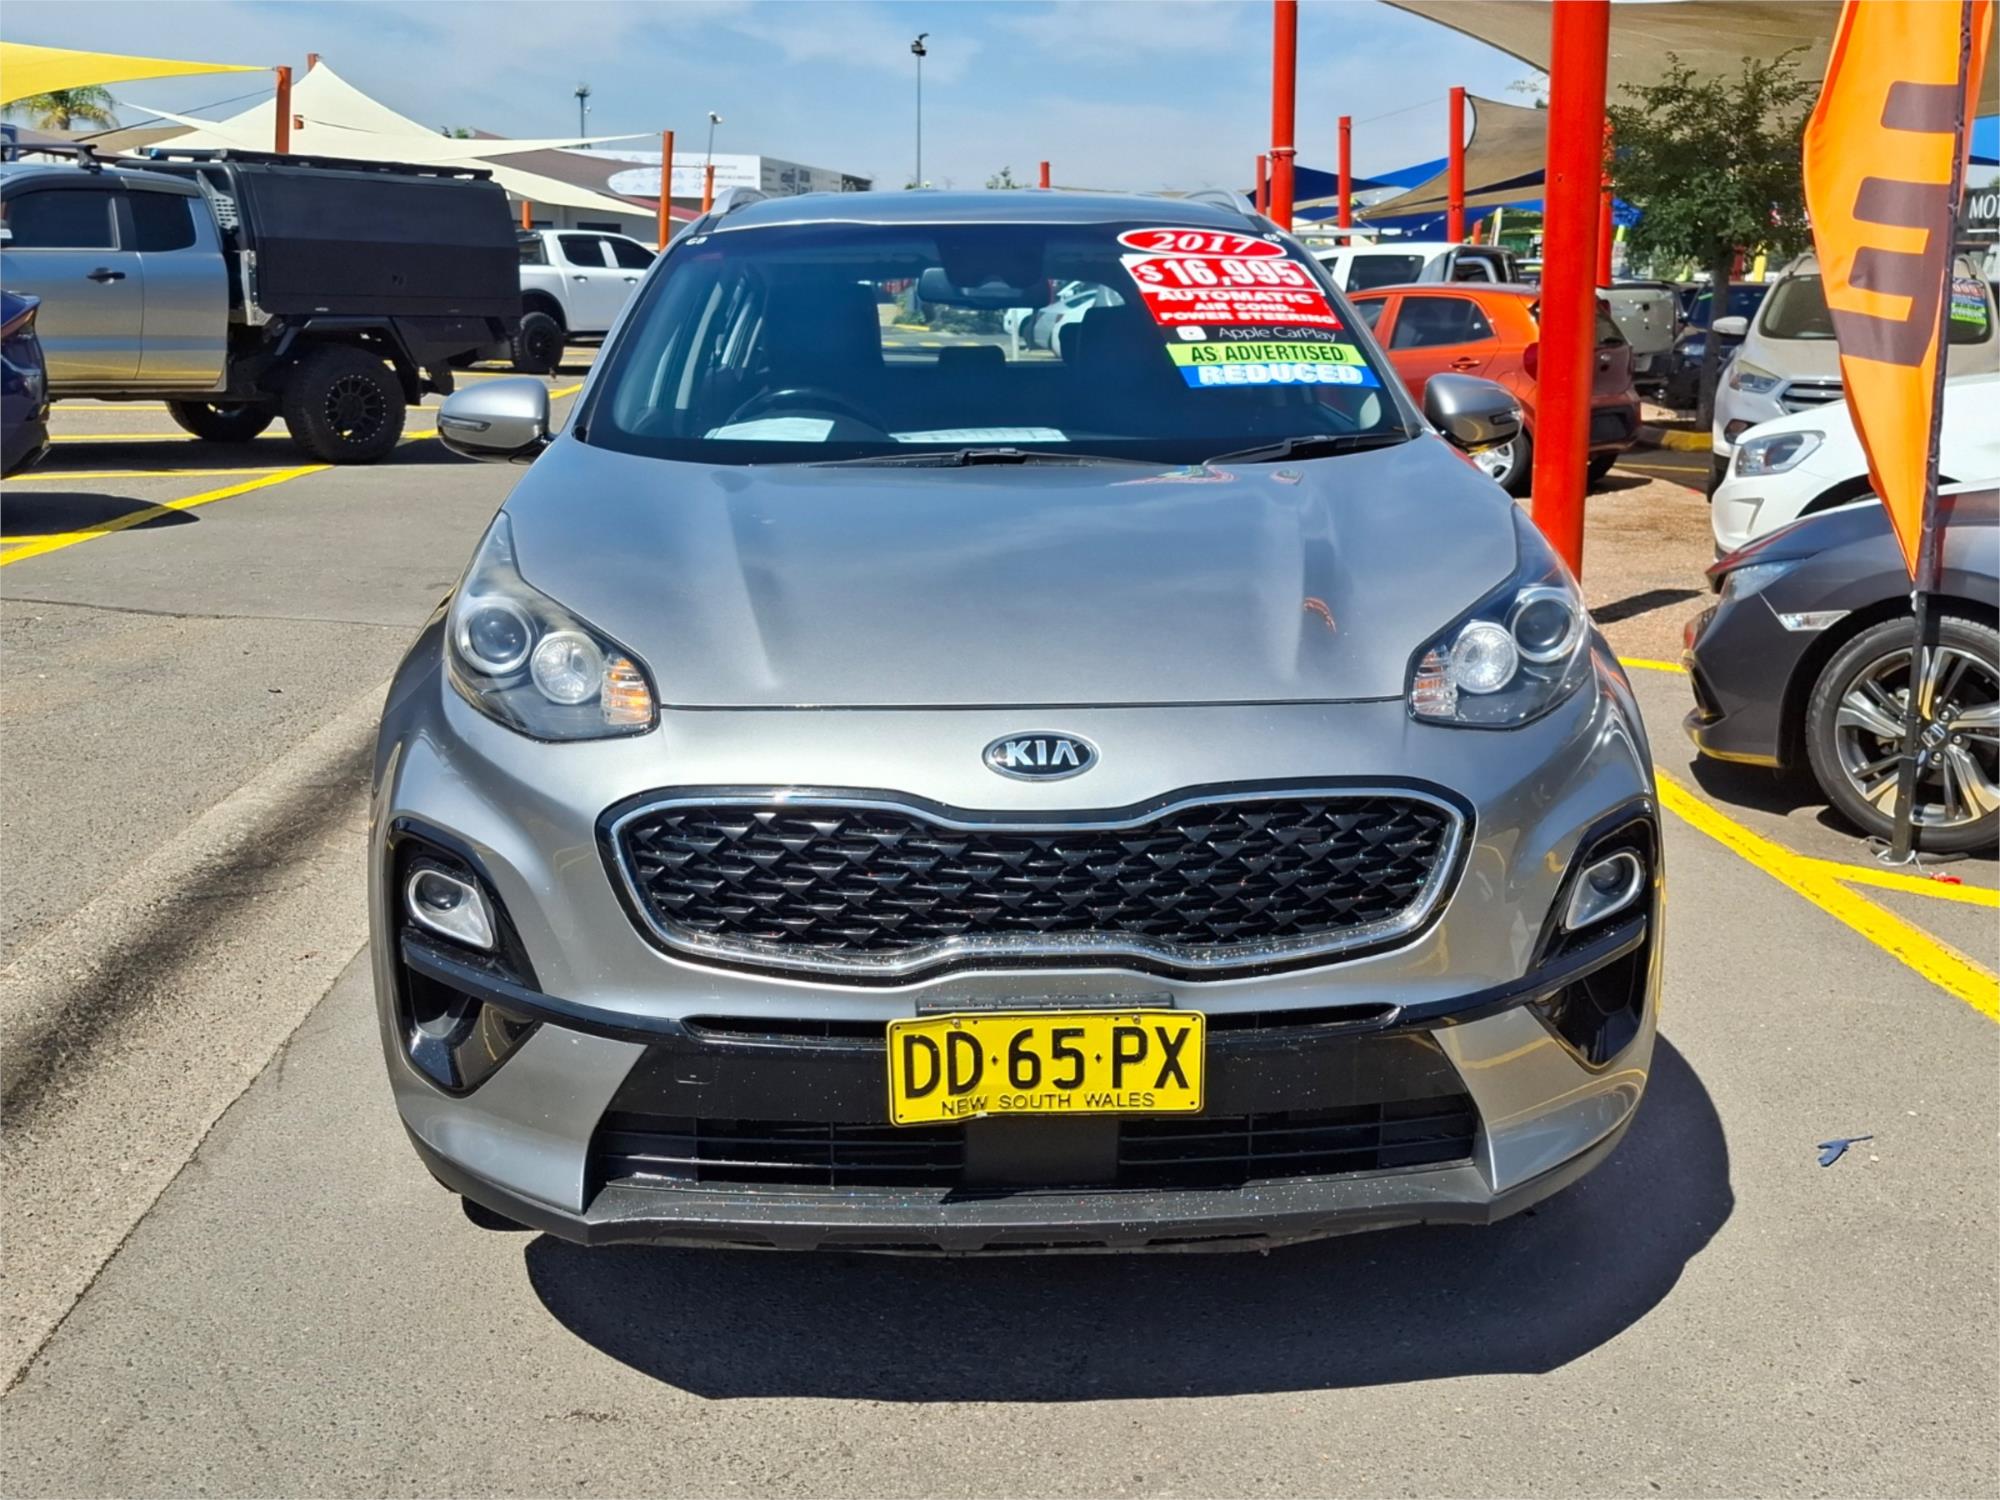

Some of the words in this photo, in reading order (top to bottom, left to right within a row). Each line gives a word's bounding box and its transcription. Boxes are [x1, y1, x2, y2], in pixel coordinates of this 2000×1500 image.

[1149, 232, 1257, 253] 2017
[1141, 259, 1305, 287] $16,995
[1157, 290, 1314, 304] AUTOMATIC
[1195, 302, 1231, 311] AIR
[1233, 302, 1296, 312] COND.
[1160, 311, 1234, 321] POWER
[1237, 312, 1337, 324] STEERING
[1218, 326, 1271, 340] Apple
[1272, 327, 1336, 342] CarPlay
[1191, 345, 1218, 362] AS
[1225, 345, 1344, 362] ADVERTISED
[1198, 364, 1364, 385] REDUCED
[1005, 740, 1080, 767] KIA
[942, 1095, 987, 1116] NEW
[1000, 1094, 1071, 1110] SOUTH
[1084, 1092, 1155, 1108] WALES
